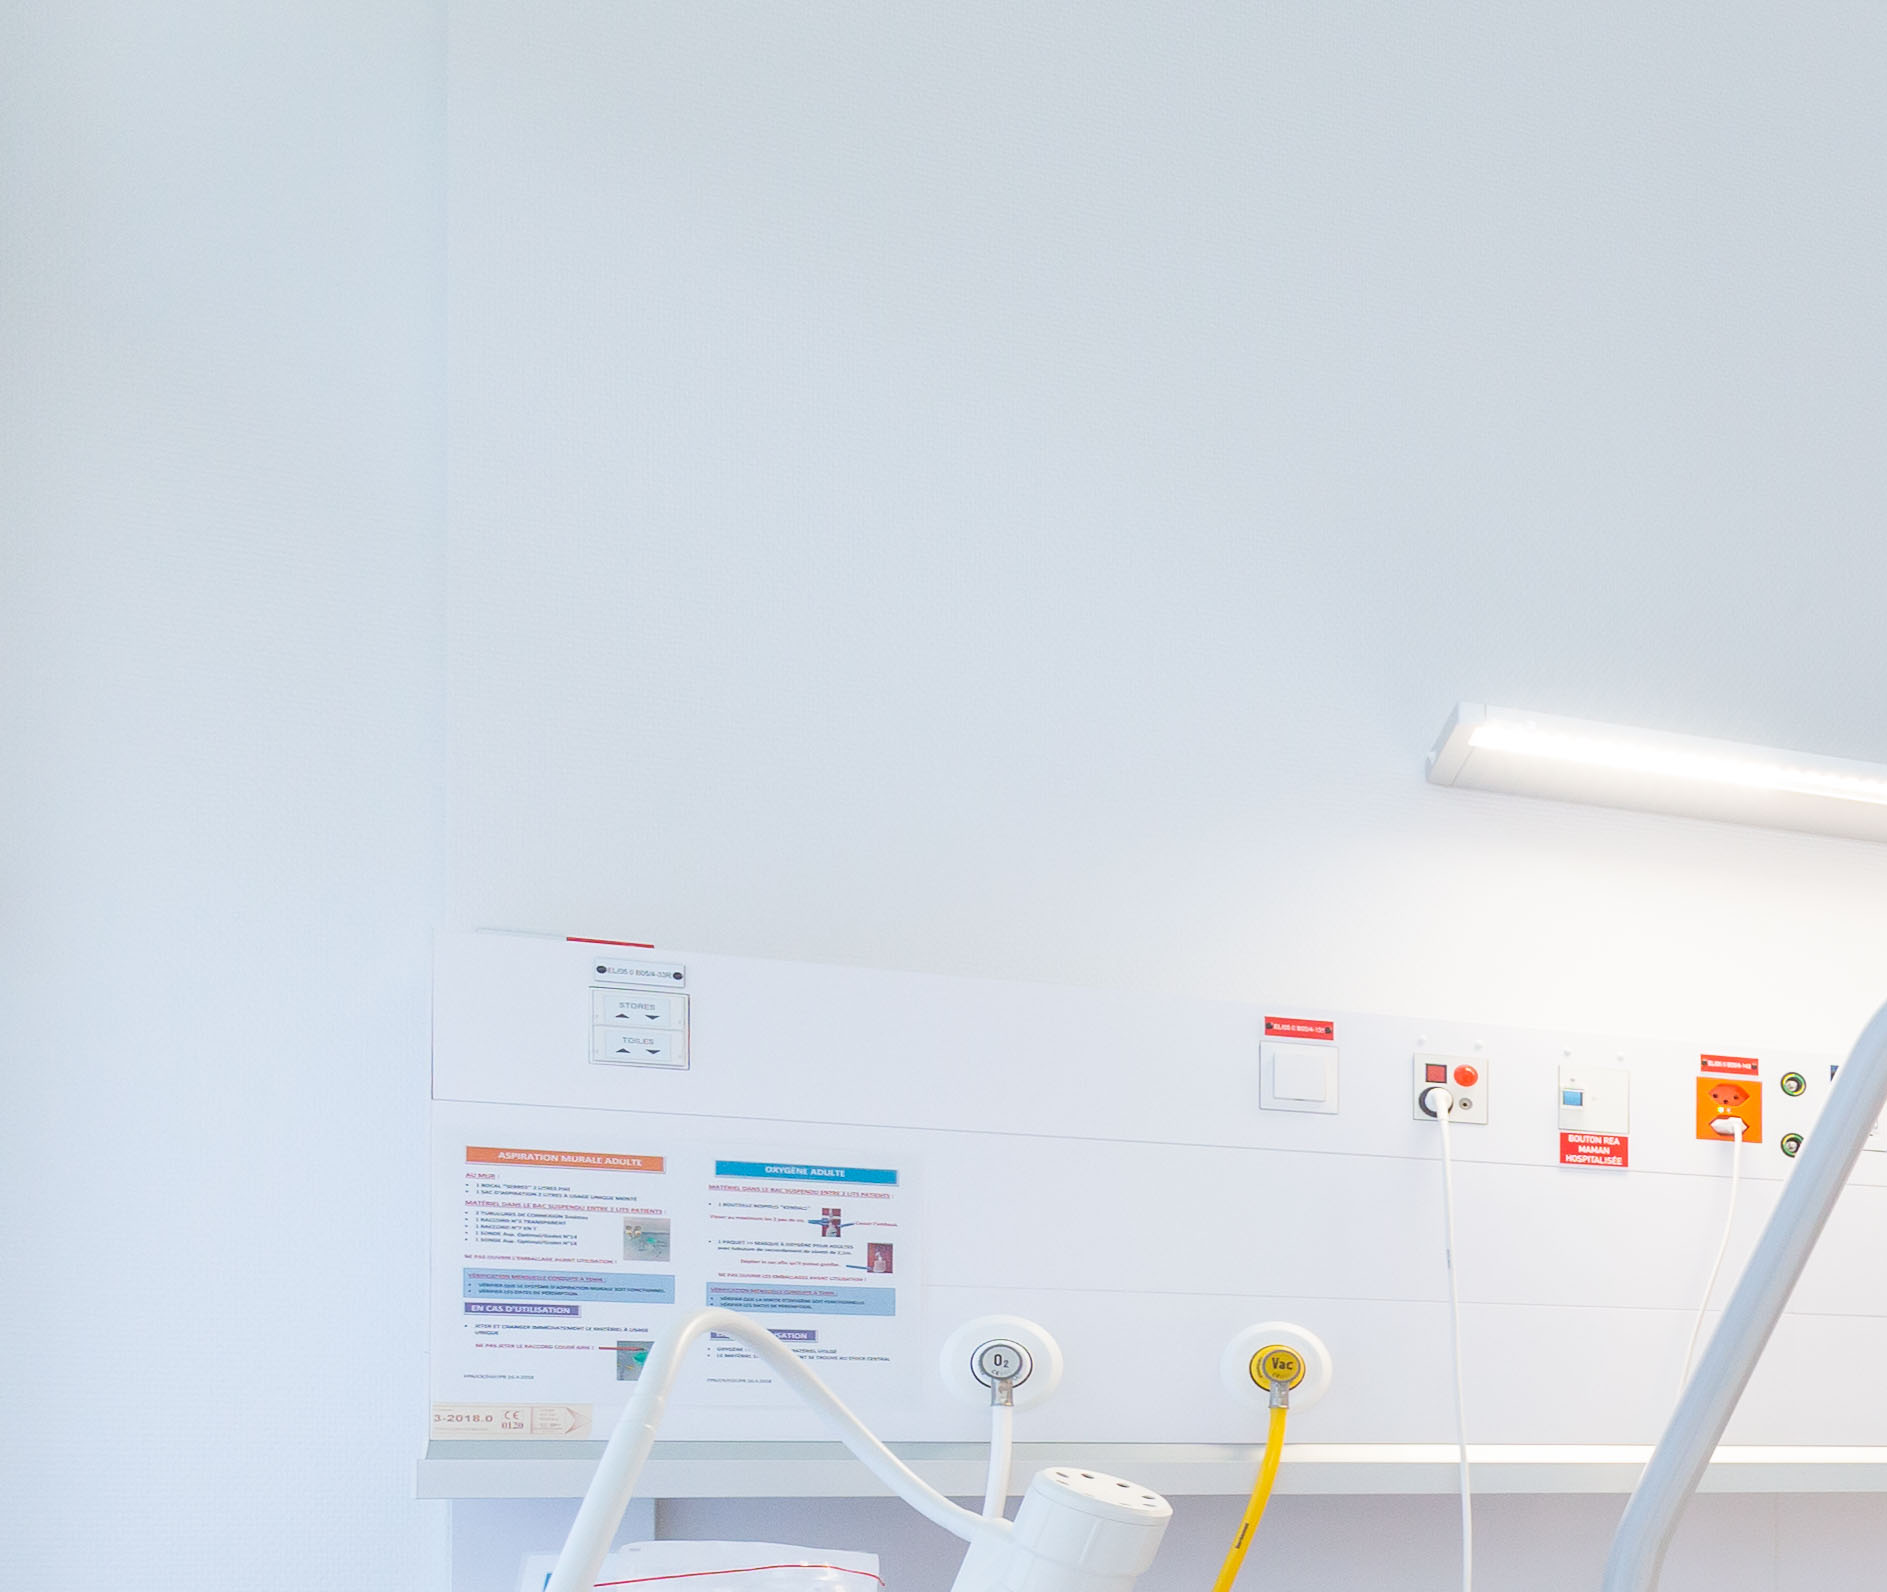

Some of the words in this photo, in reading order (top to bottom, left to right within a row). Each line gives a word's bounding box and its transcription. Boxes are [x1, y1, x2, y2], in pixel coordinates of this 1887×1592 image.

[619, 1001, 656, 1011] STORES
[622, 1036, 654, 1045] TOILES
[1568, 1134, 1602, 1144] BOUTON
[1603, 1137, 1621, 1146] REA
[1578, 1145, 1611, 1155] MAMAN
[498, 1151, 560, 1162] ASPIRATION
[560, 1154, 603, 1165] MURALE
[605, 1156, 643, 1167] ADULTE
[1565, 1154, 1623, 1166] HOSPITALISÉE
[764, 1165, 808, 1176] OXYGÈNE
[810, 1168, 846, 1178] ADULTE
[506, 1306, 571, 1314] D'UTILISATION
[1271, 1357, 1294, 1370] Vac
[433, 1414, 494, 1423] 3-2018.0
[501, 1421, 524, 1430] 0120
